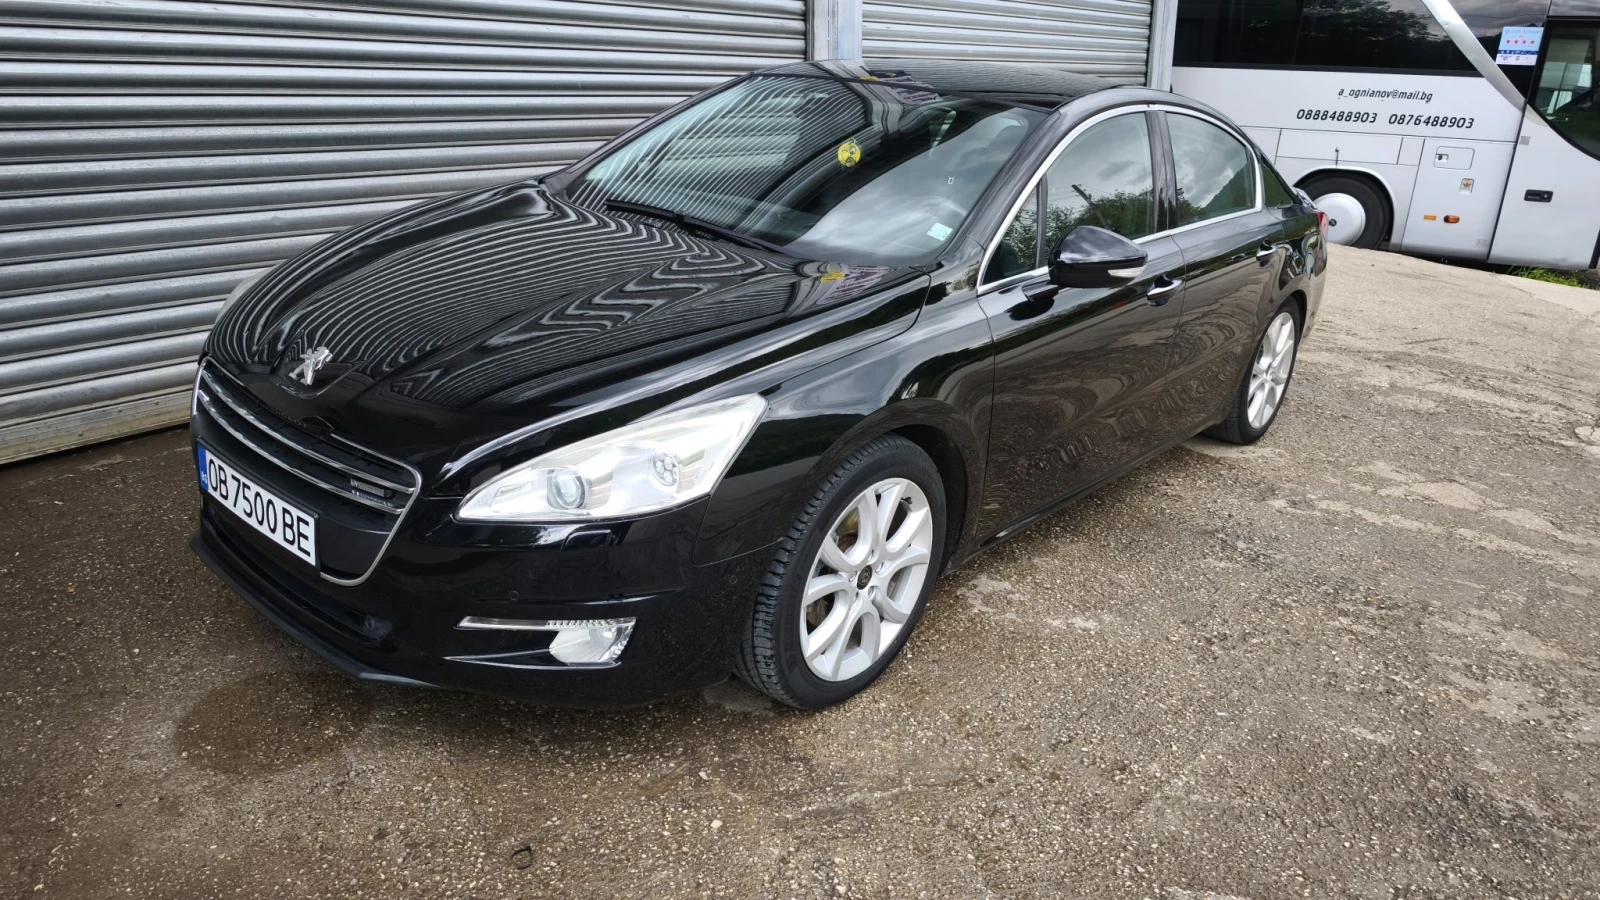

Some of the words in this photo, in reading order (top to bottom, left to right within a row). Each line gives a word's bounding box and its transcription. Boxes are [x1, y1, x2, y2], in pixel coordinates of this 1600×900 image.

[1338, 88, 1433, 103] a_ognianov@mail.bg
[1296, 109, 1377, 123] 0888488903
[1388, 113, 1475, 129] 0876488903
[209, 458, 229, 501] OB
[231, 474, 277, 534] 7500
[282, 507, 311, 557] BE
